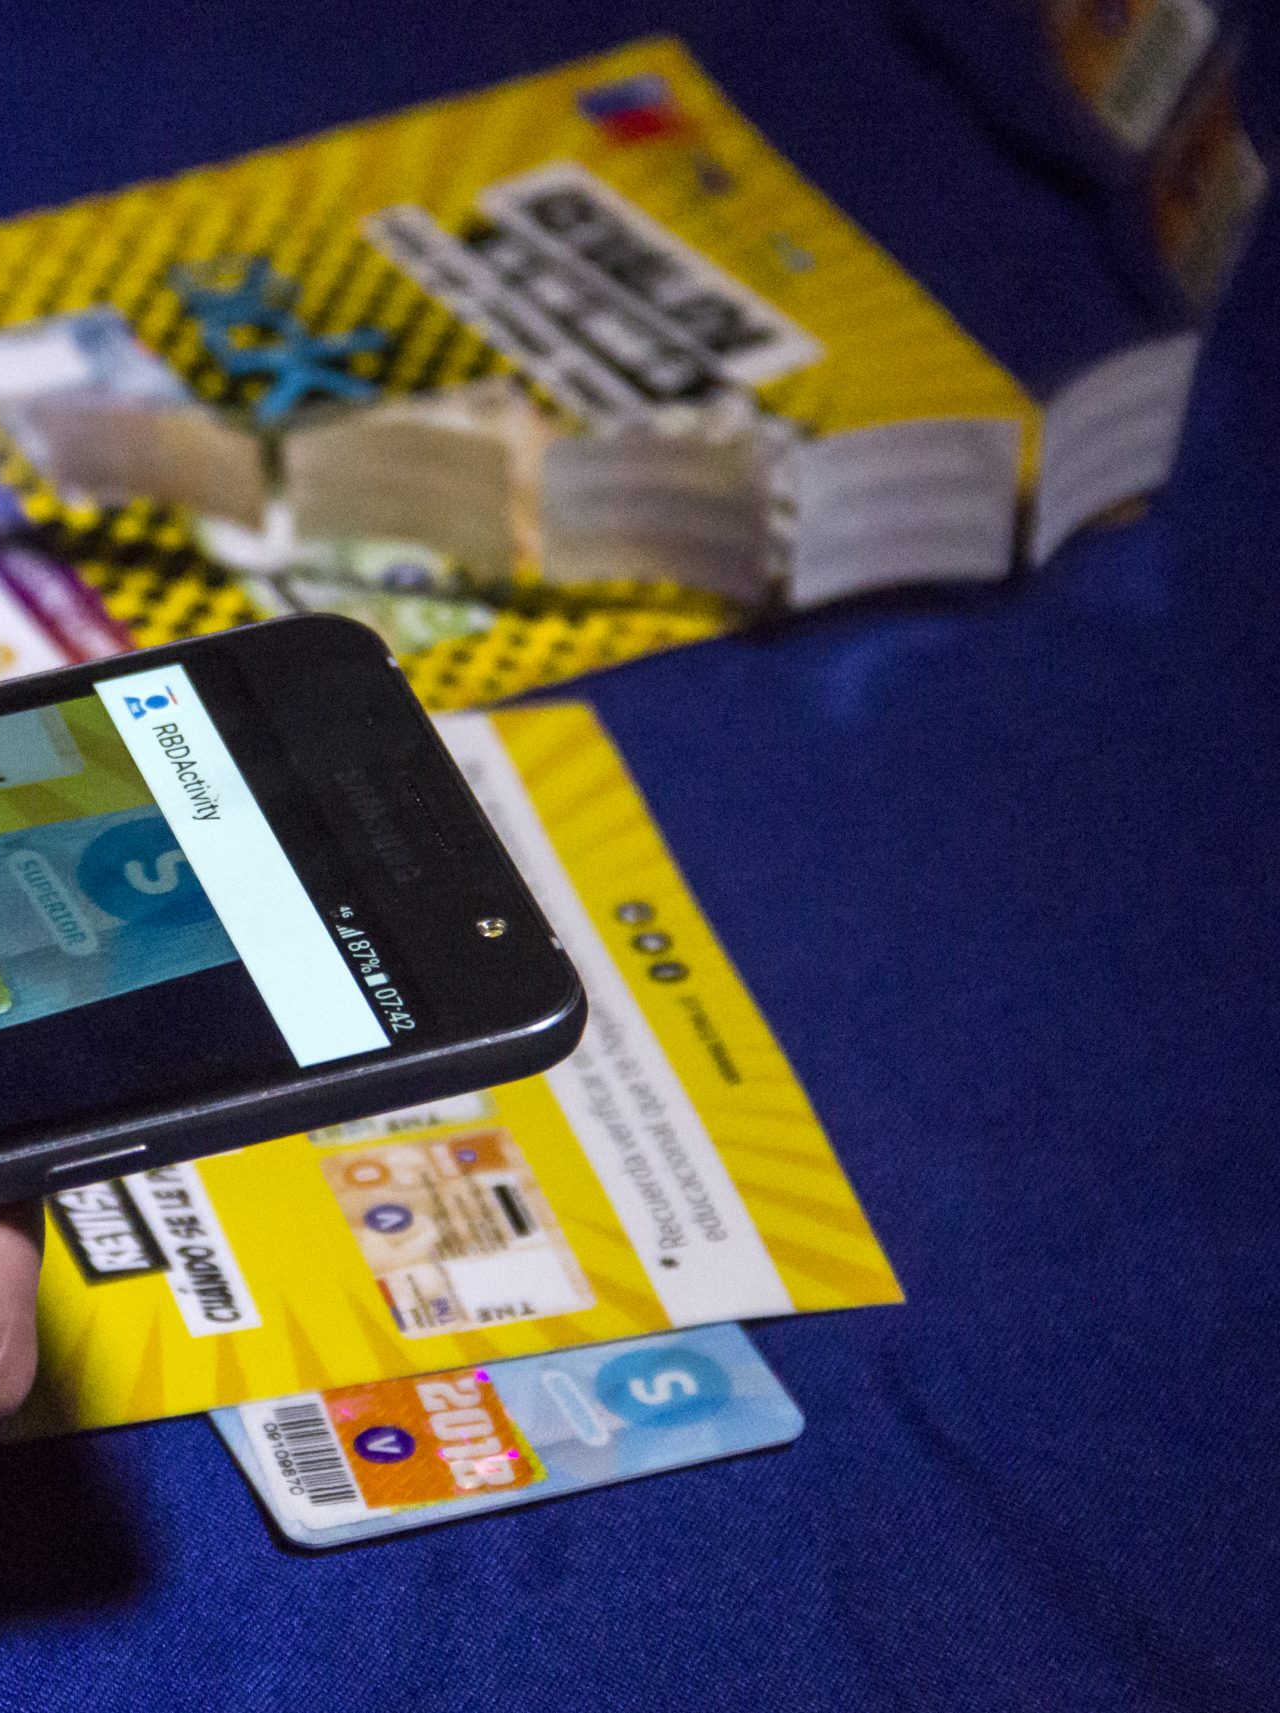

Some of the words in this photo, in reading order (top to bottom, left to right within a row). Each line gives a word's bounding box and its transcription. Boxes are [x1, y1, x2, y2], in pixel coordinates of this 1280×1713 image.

[151, 722, 221, 821] RBDActivity
[22, 857, 90, 949] SUPERIOR
[339, 905, 354, 919] 4G
[348, 939, 381, 974] 87%
[375, 987, 417, 1034] 07:42
[163, 1214, 209, 1240] SE
[624, 1154, 690, 1251] Recuerda
[176, 1245, 243, 1324] CUÁNDO
[627, 1370, 701, 1406] S
[261, 1421, 306, 1497] 09109870
[415, 1374, 519, 1491] 2018
